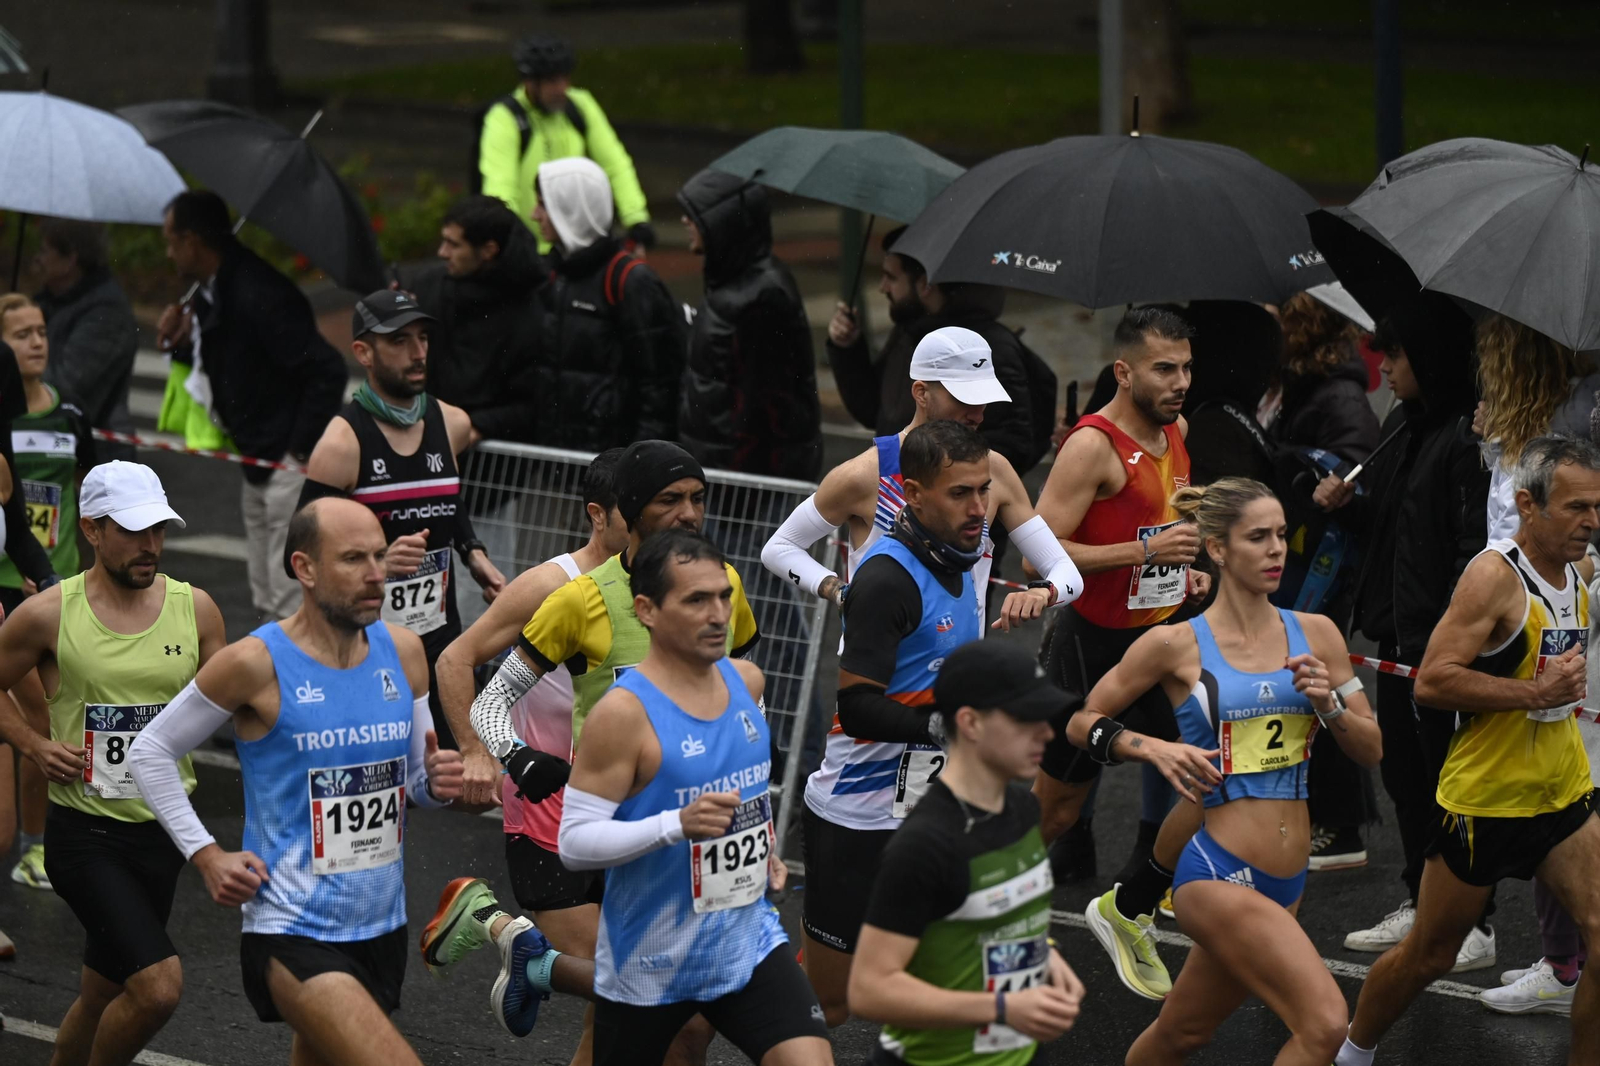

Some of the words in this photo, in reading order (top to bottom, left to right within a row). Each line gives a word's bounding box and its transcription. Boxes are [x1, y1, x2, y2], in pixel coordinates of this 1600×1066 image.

[1158, 581, 1179, 591] FERNANDO
[391, 578, 435, 611] 872
[1227, 706, 1305, 720] TROTASIERRA
[97, 715, 117, 730] 59
[1266, 719, 1284, 750] 2
[1260, 755, 1290, 767] CAROLINA
[324, 779, 346, 797] 59
[326, 792, 398, 835] 1924
[351, 836, 382, 849] FERNANDO
[704, 829, 769, 875] 1923
